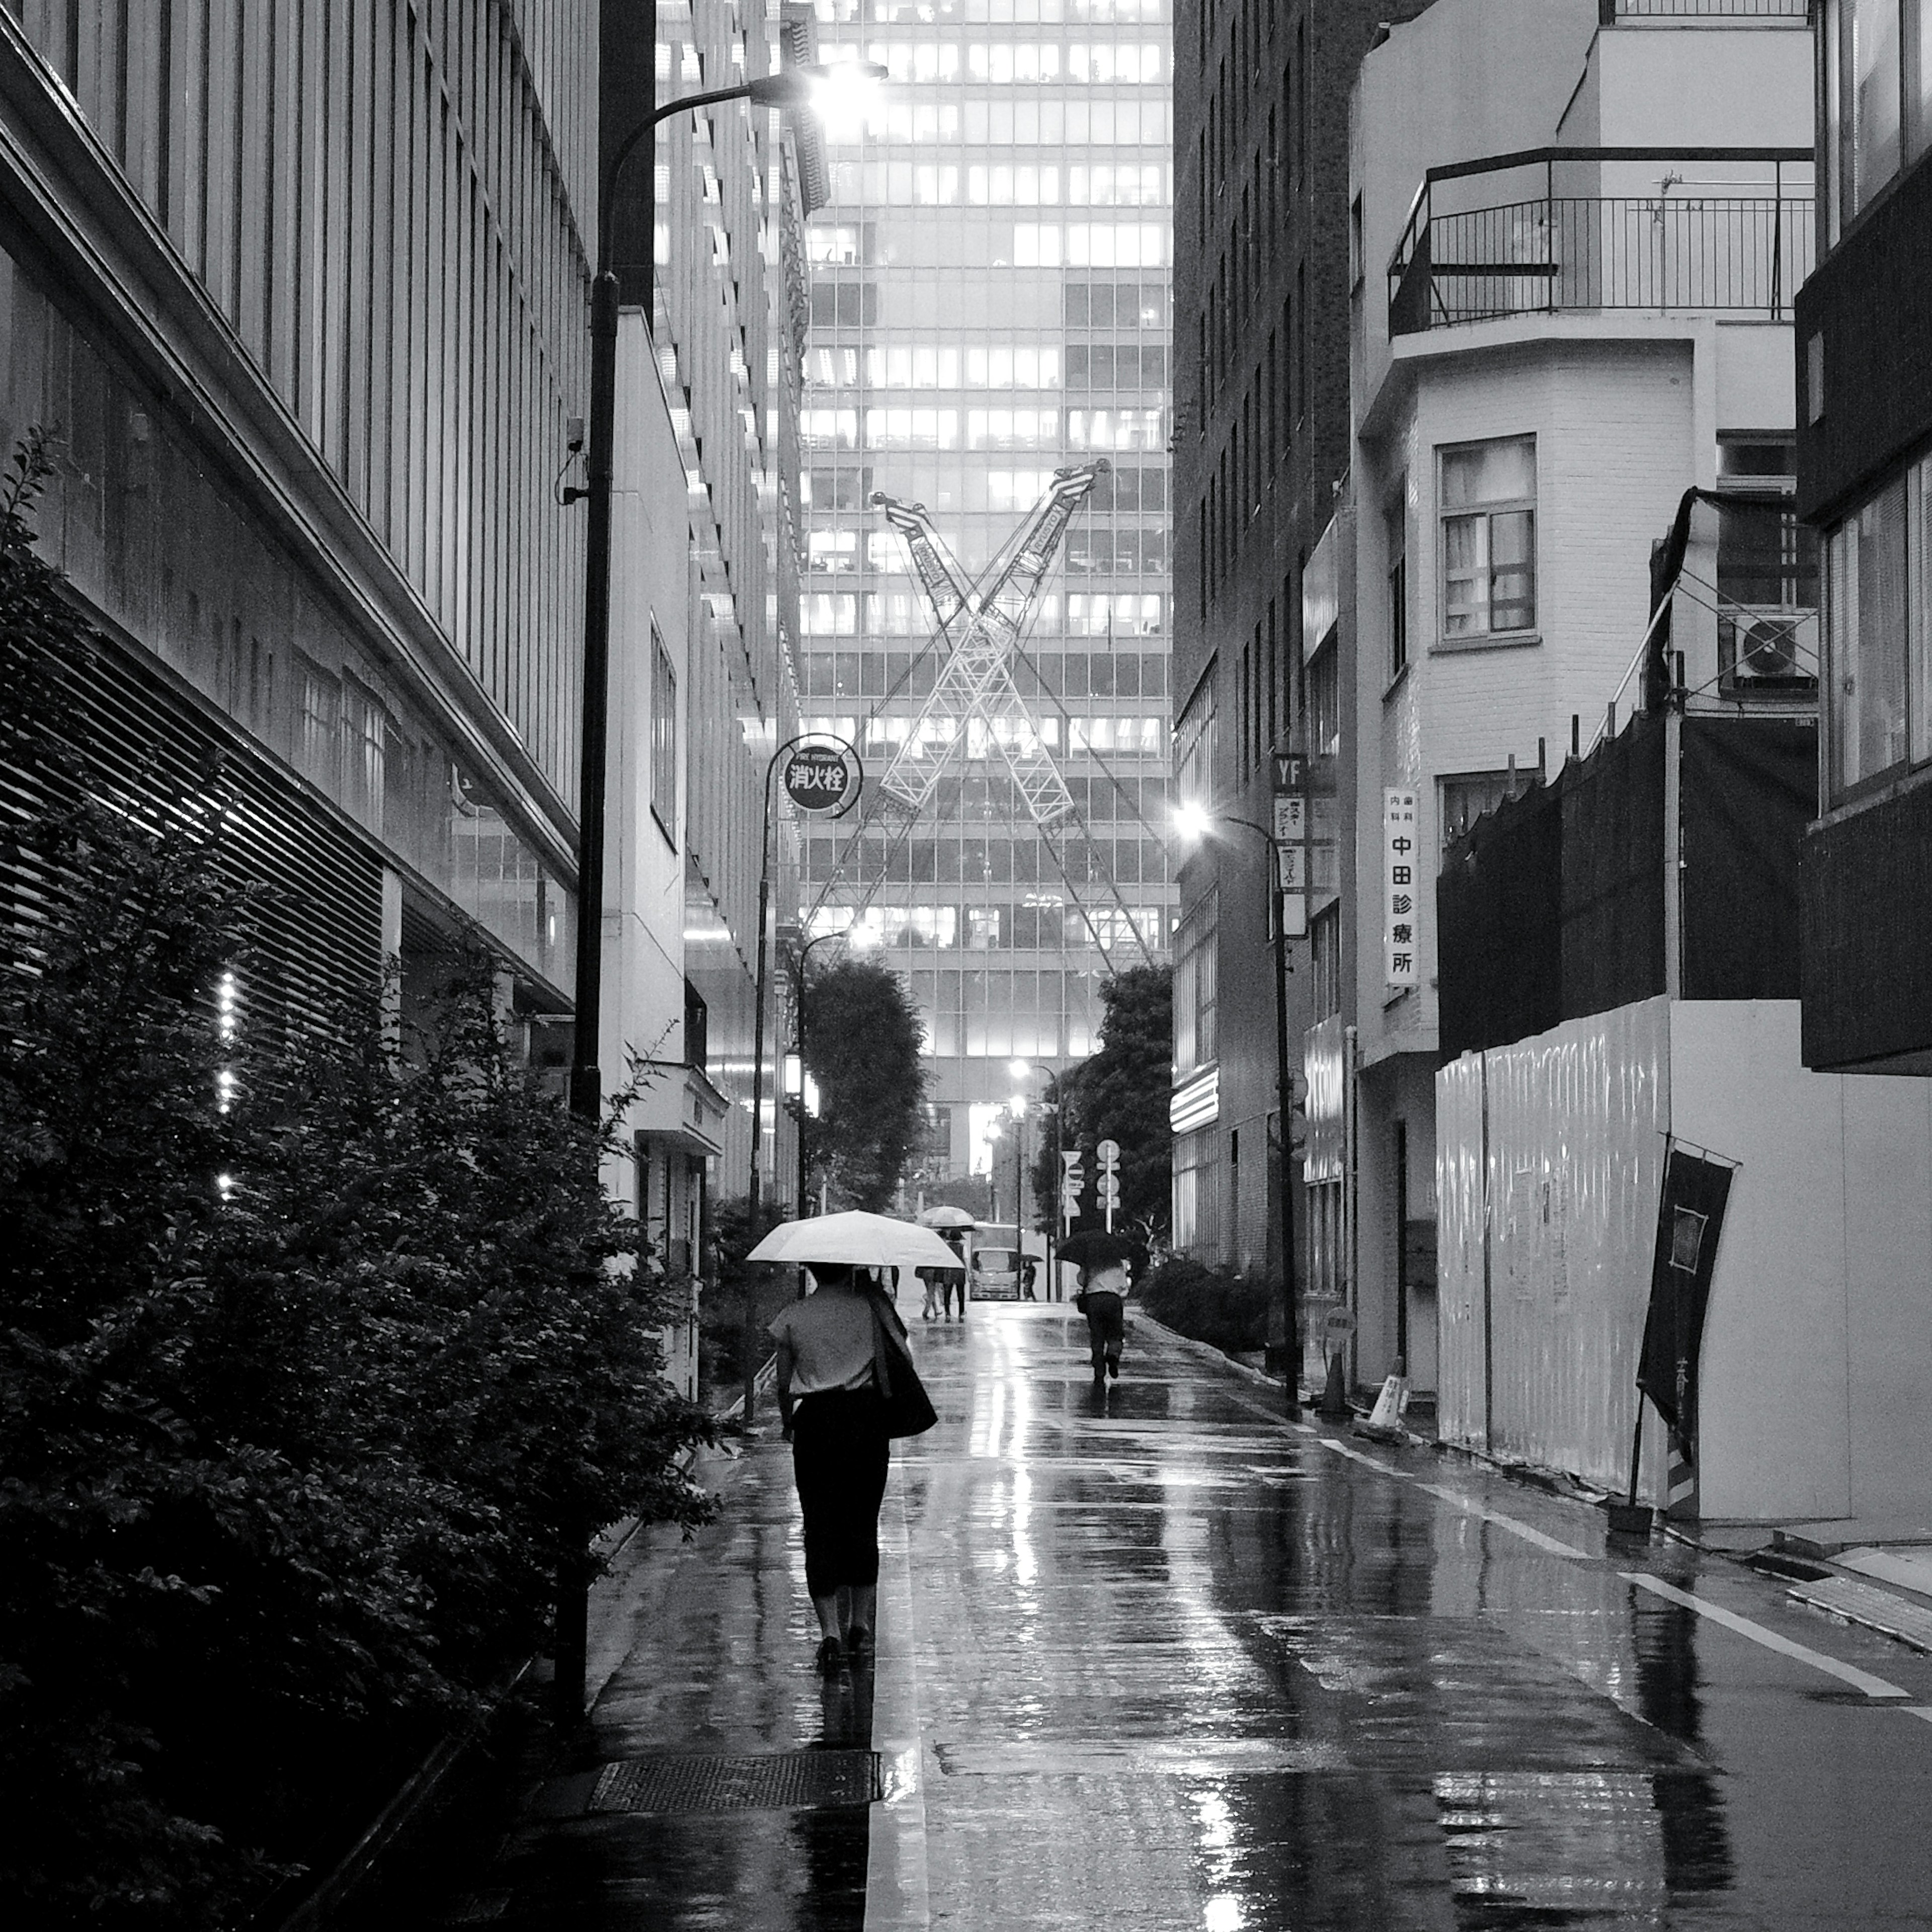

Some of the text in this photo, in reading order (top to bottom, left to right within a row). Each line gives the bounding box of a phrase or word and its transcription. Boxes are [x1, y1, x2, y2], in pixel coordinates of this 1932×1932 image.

[1034, 515, 1057, 551] RYUSYO
[919, 546, 939, 580] RYUSYO
[789, 764, 845, 791] 消火栓
[1279, 759, 1300, 785] YF
[1390, 795, 1400, 822] 内科
[1392, 836, 1412, 973] 中田診療所
